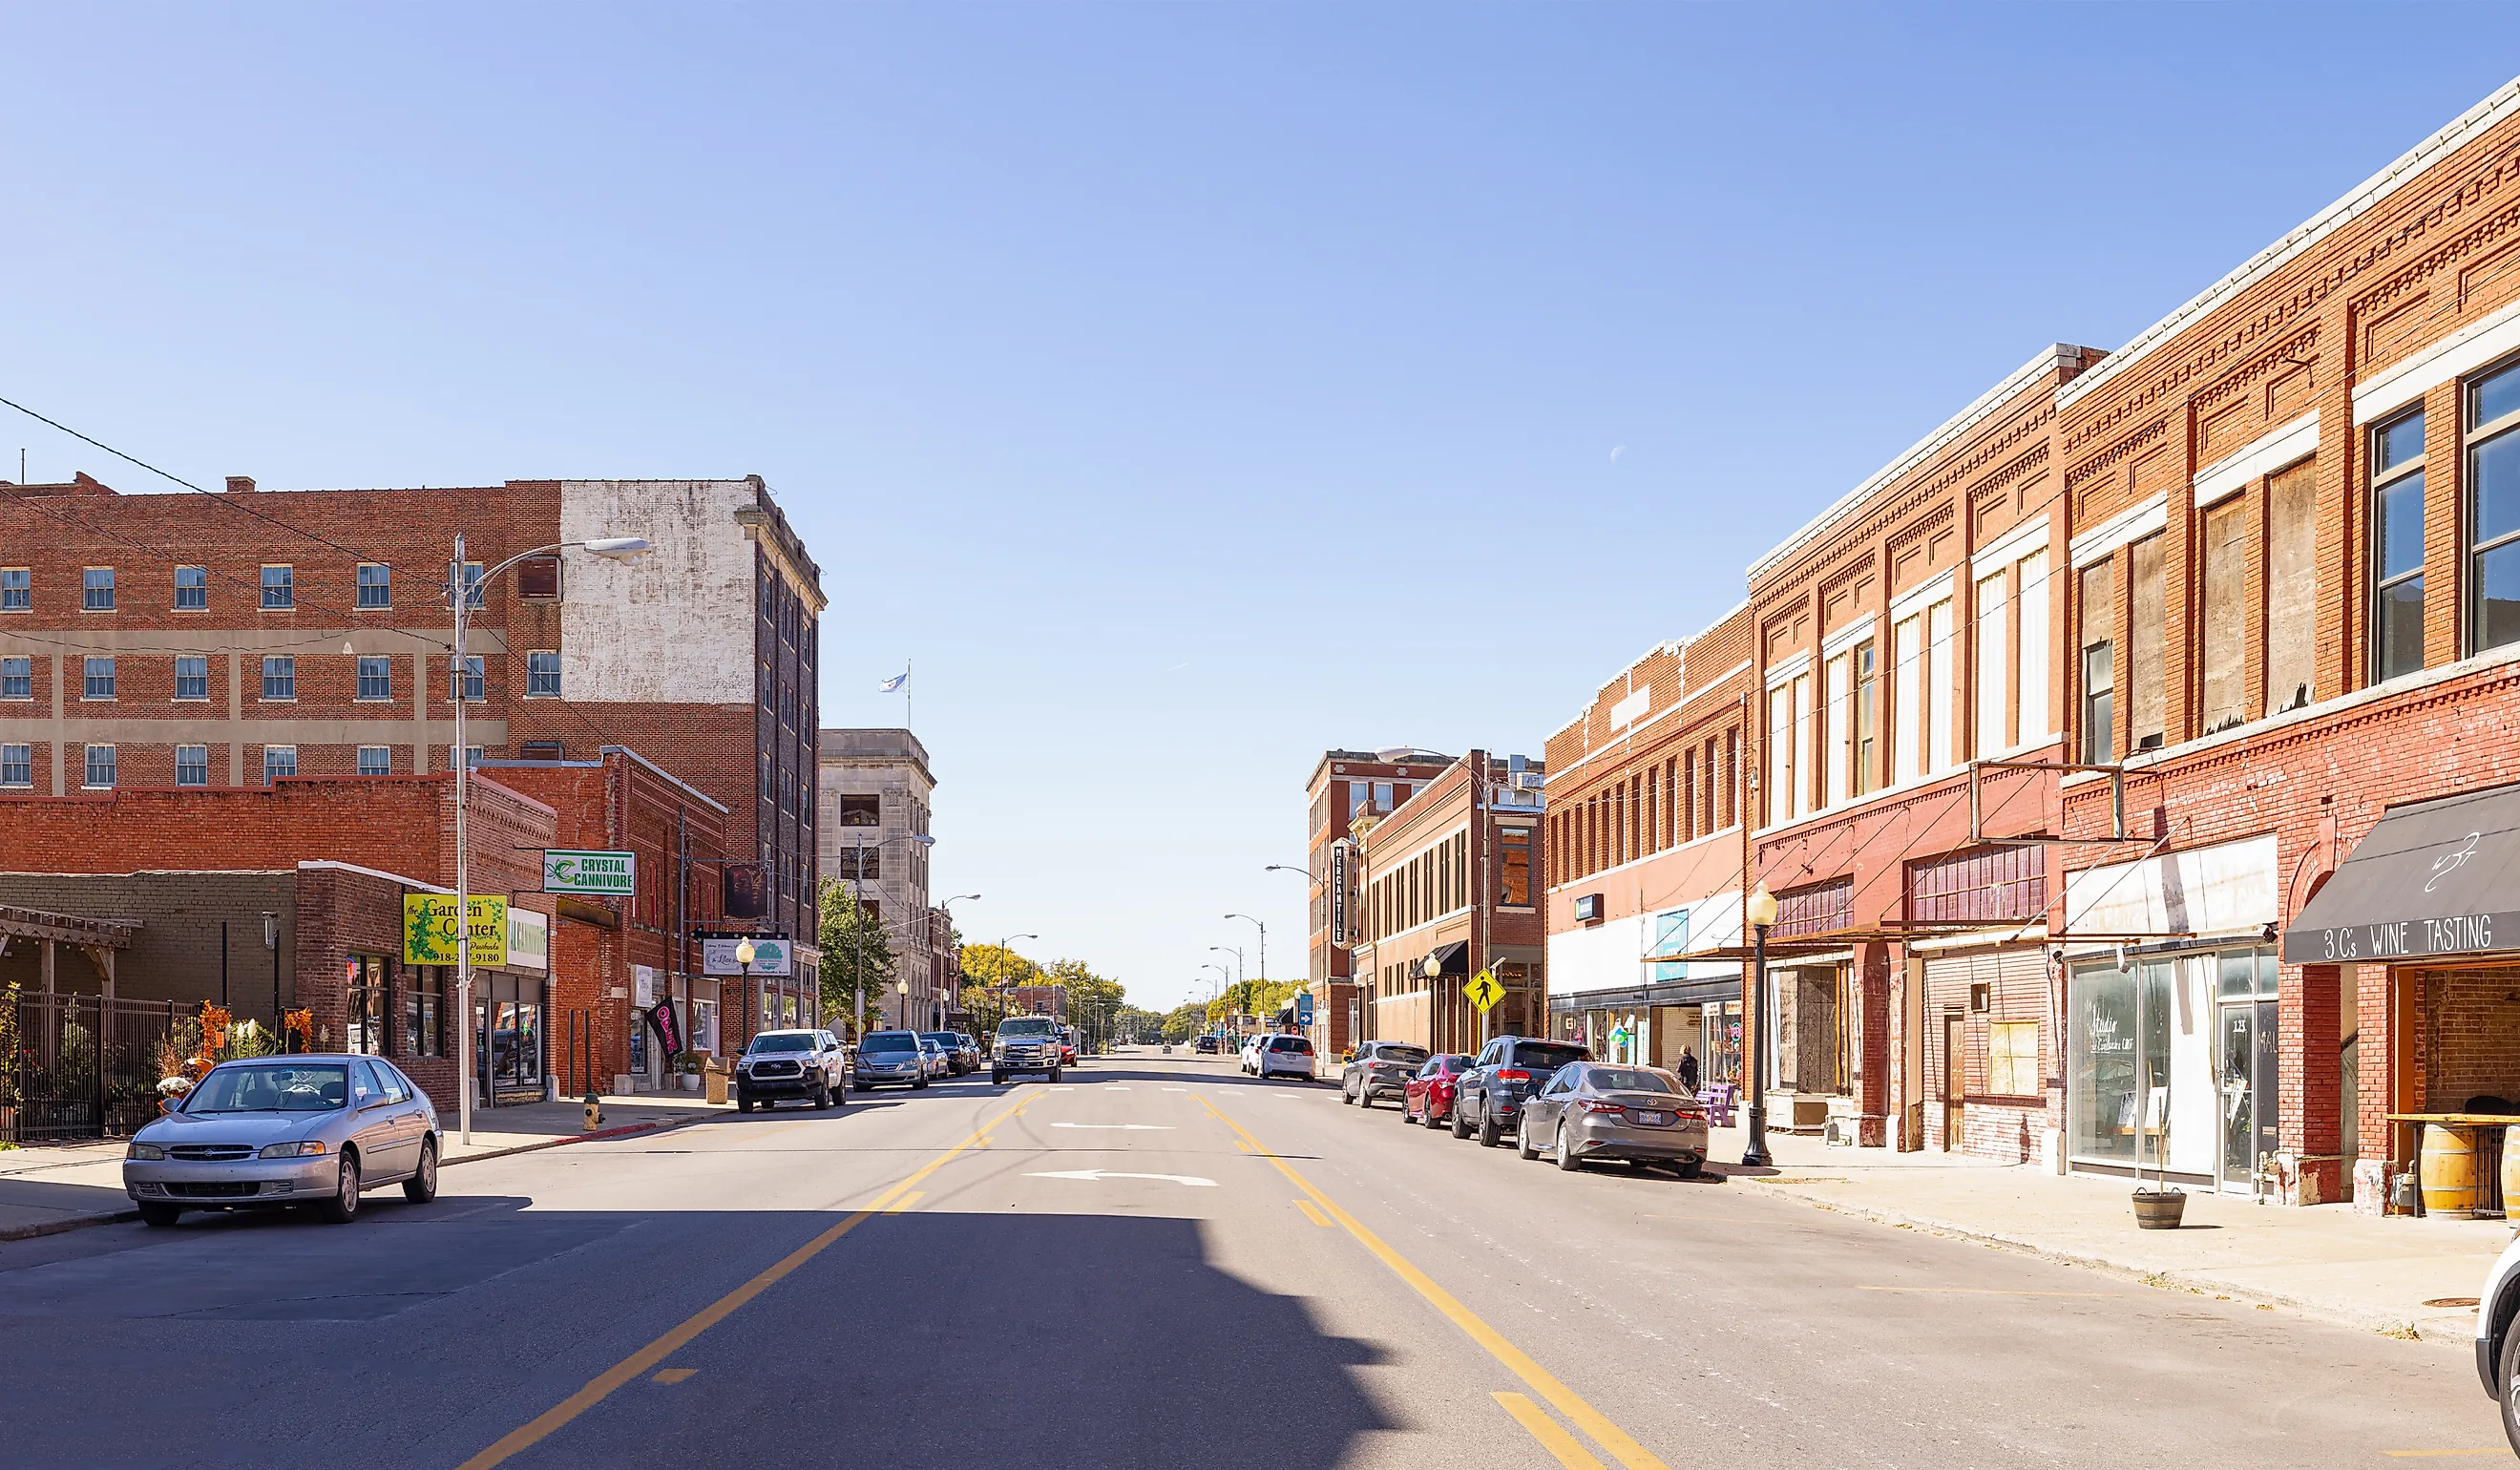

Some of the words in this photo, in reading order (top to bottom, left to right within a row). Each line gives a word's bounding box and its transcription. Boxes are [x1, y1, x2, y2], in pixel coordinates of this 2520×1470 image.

[581, 858, 626, 873] CRYSTAL
[574, 872, 632, 888] CANNIVORE
[407, 904, 419, 915] the
[443, 918, 496, 936] Cnter
[2324, 929, 2335, 959] 3
[2369, 921, 2409, 956] WINE
[2423, 914, 2492, 952] TASTING
[433, 953, 499, 963] 918-2-9180
